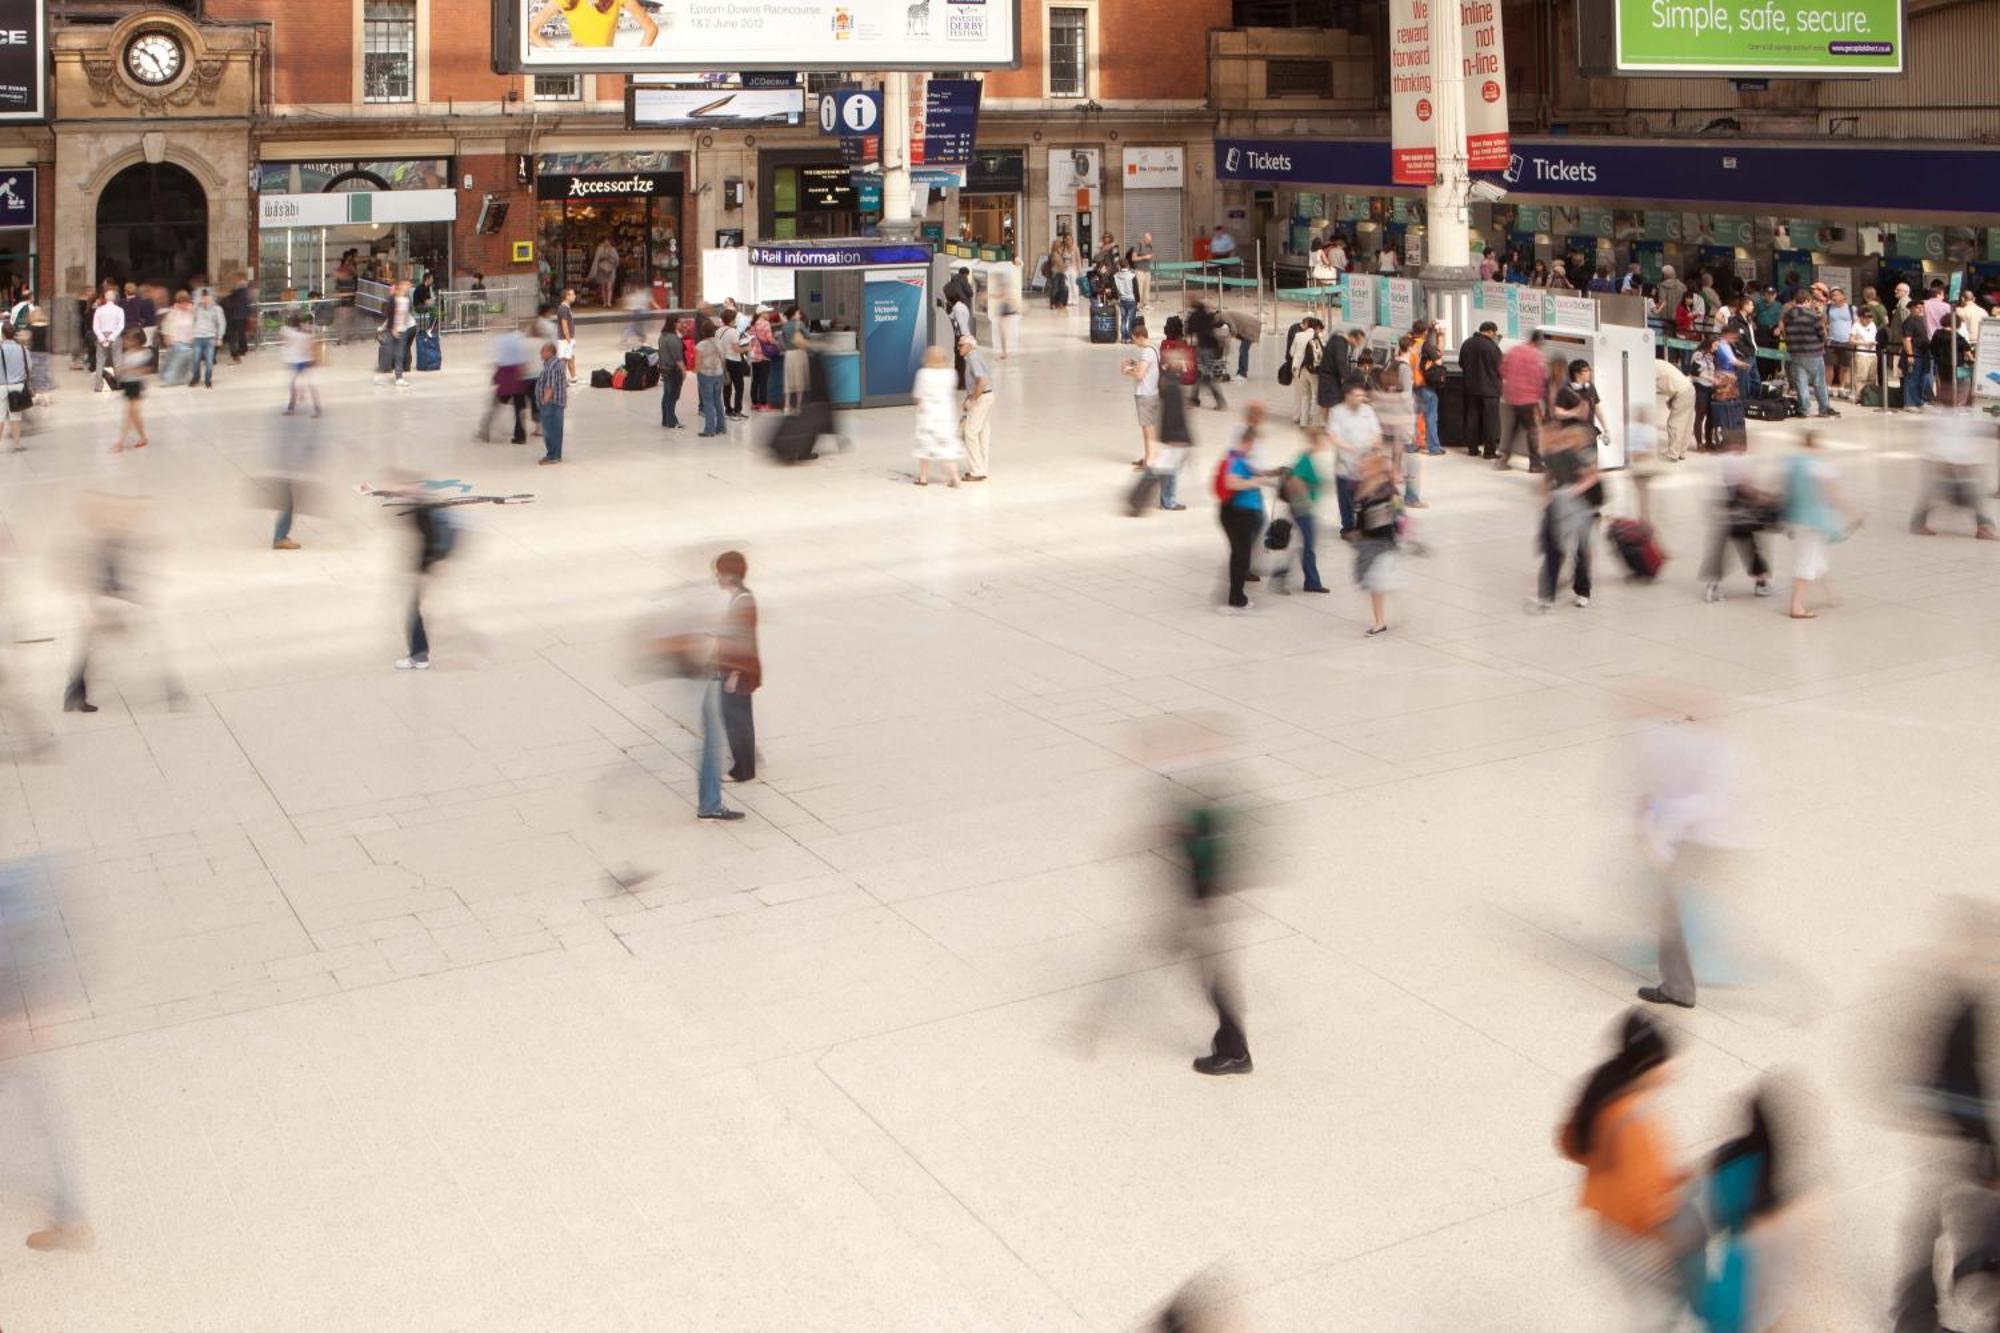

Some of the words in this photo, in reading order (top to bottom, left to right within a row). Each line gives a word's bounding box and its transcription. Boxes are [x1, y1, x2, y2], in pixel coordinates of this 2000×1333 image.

[690, 4, 725, 15] Epsom
[727, 4, 761, 14] Downs
[764, 4, 821, 14] Racecourse
[1413, 0, 1428, 19] We
[1651, 0, 1733, 36] Simple,
[1739, 1, 1790, 35] safe,
[1796, 10, 1871, 33] secure.
[713, 18, 738, 29] June
[740, 18, 765, 29] 2012
[950, 22, 983, 30] DERBY
[1397, 23, 1429, 43] reward
[1475, 26, 1495, 48] not
[1392, 47, 1430, 67] forward
[1463, 52, 1498, 77] n-line
[1393, 73, 1432, 93] thinking
[1247, 152, 1292, 171] Tickets
[1533, 158, 1597, 182] Tickets
[569, 175, 654, 197] Accessorize
[264, 201, 300, 217] wasabi
[762, 250, 781, 263] Rail
[785, 250, 861, 264] information
[874, 305, 899, 313] Victoria
[1519, 303, 1540, 315] ticket
